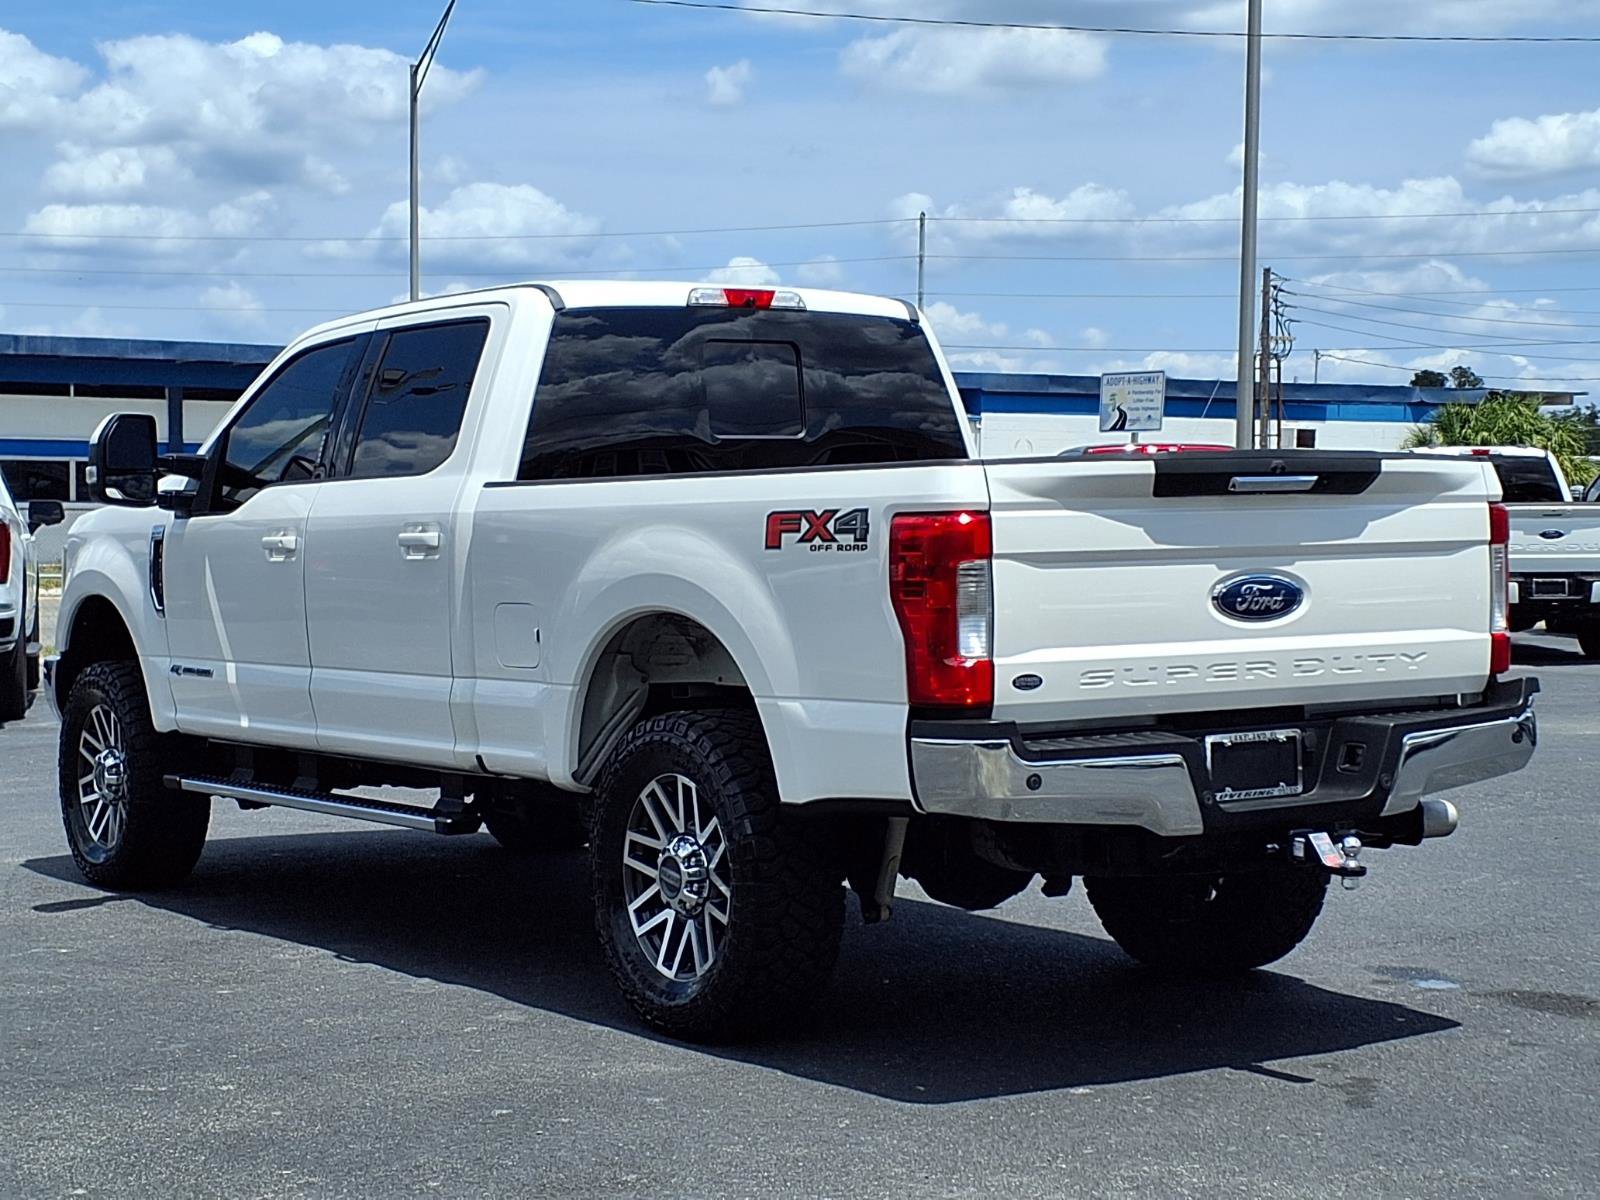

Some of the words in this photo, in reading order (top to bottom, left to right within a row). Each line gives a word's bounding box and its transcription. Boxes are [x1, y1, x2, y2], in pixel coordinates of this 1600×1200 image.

[765, 508, 869, 550] FX4
[809, 544, 833, 552] OFF
[836, 544, 868, 552] ROAD
[1508, 543, 1560, 552] PER
[1565, 543, 1599, 551] DU
[1236, 584, 1285, 611] Ford
[1079, 660, 1278, 689] SUPER
[1293, 651, 1428, 677] DUTY
